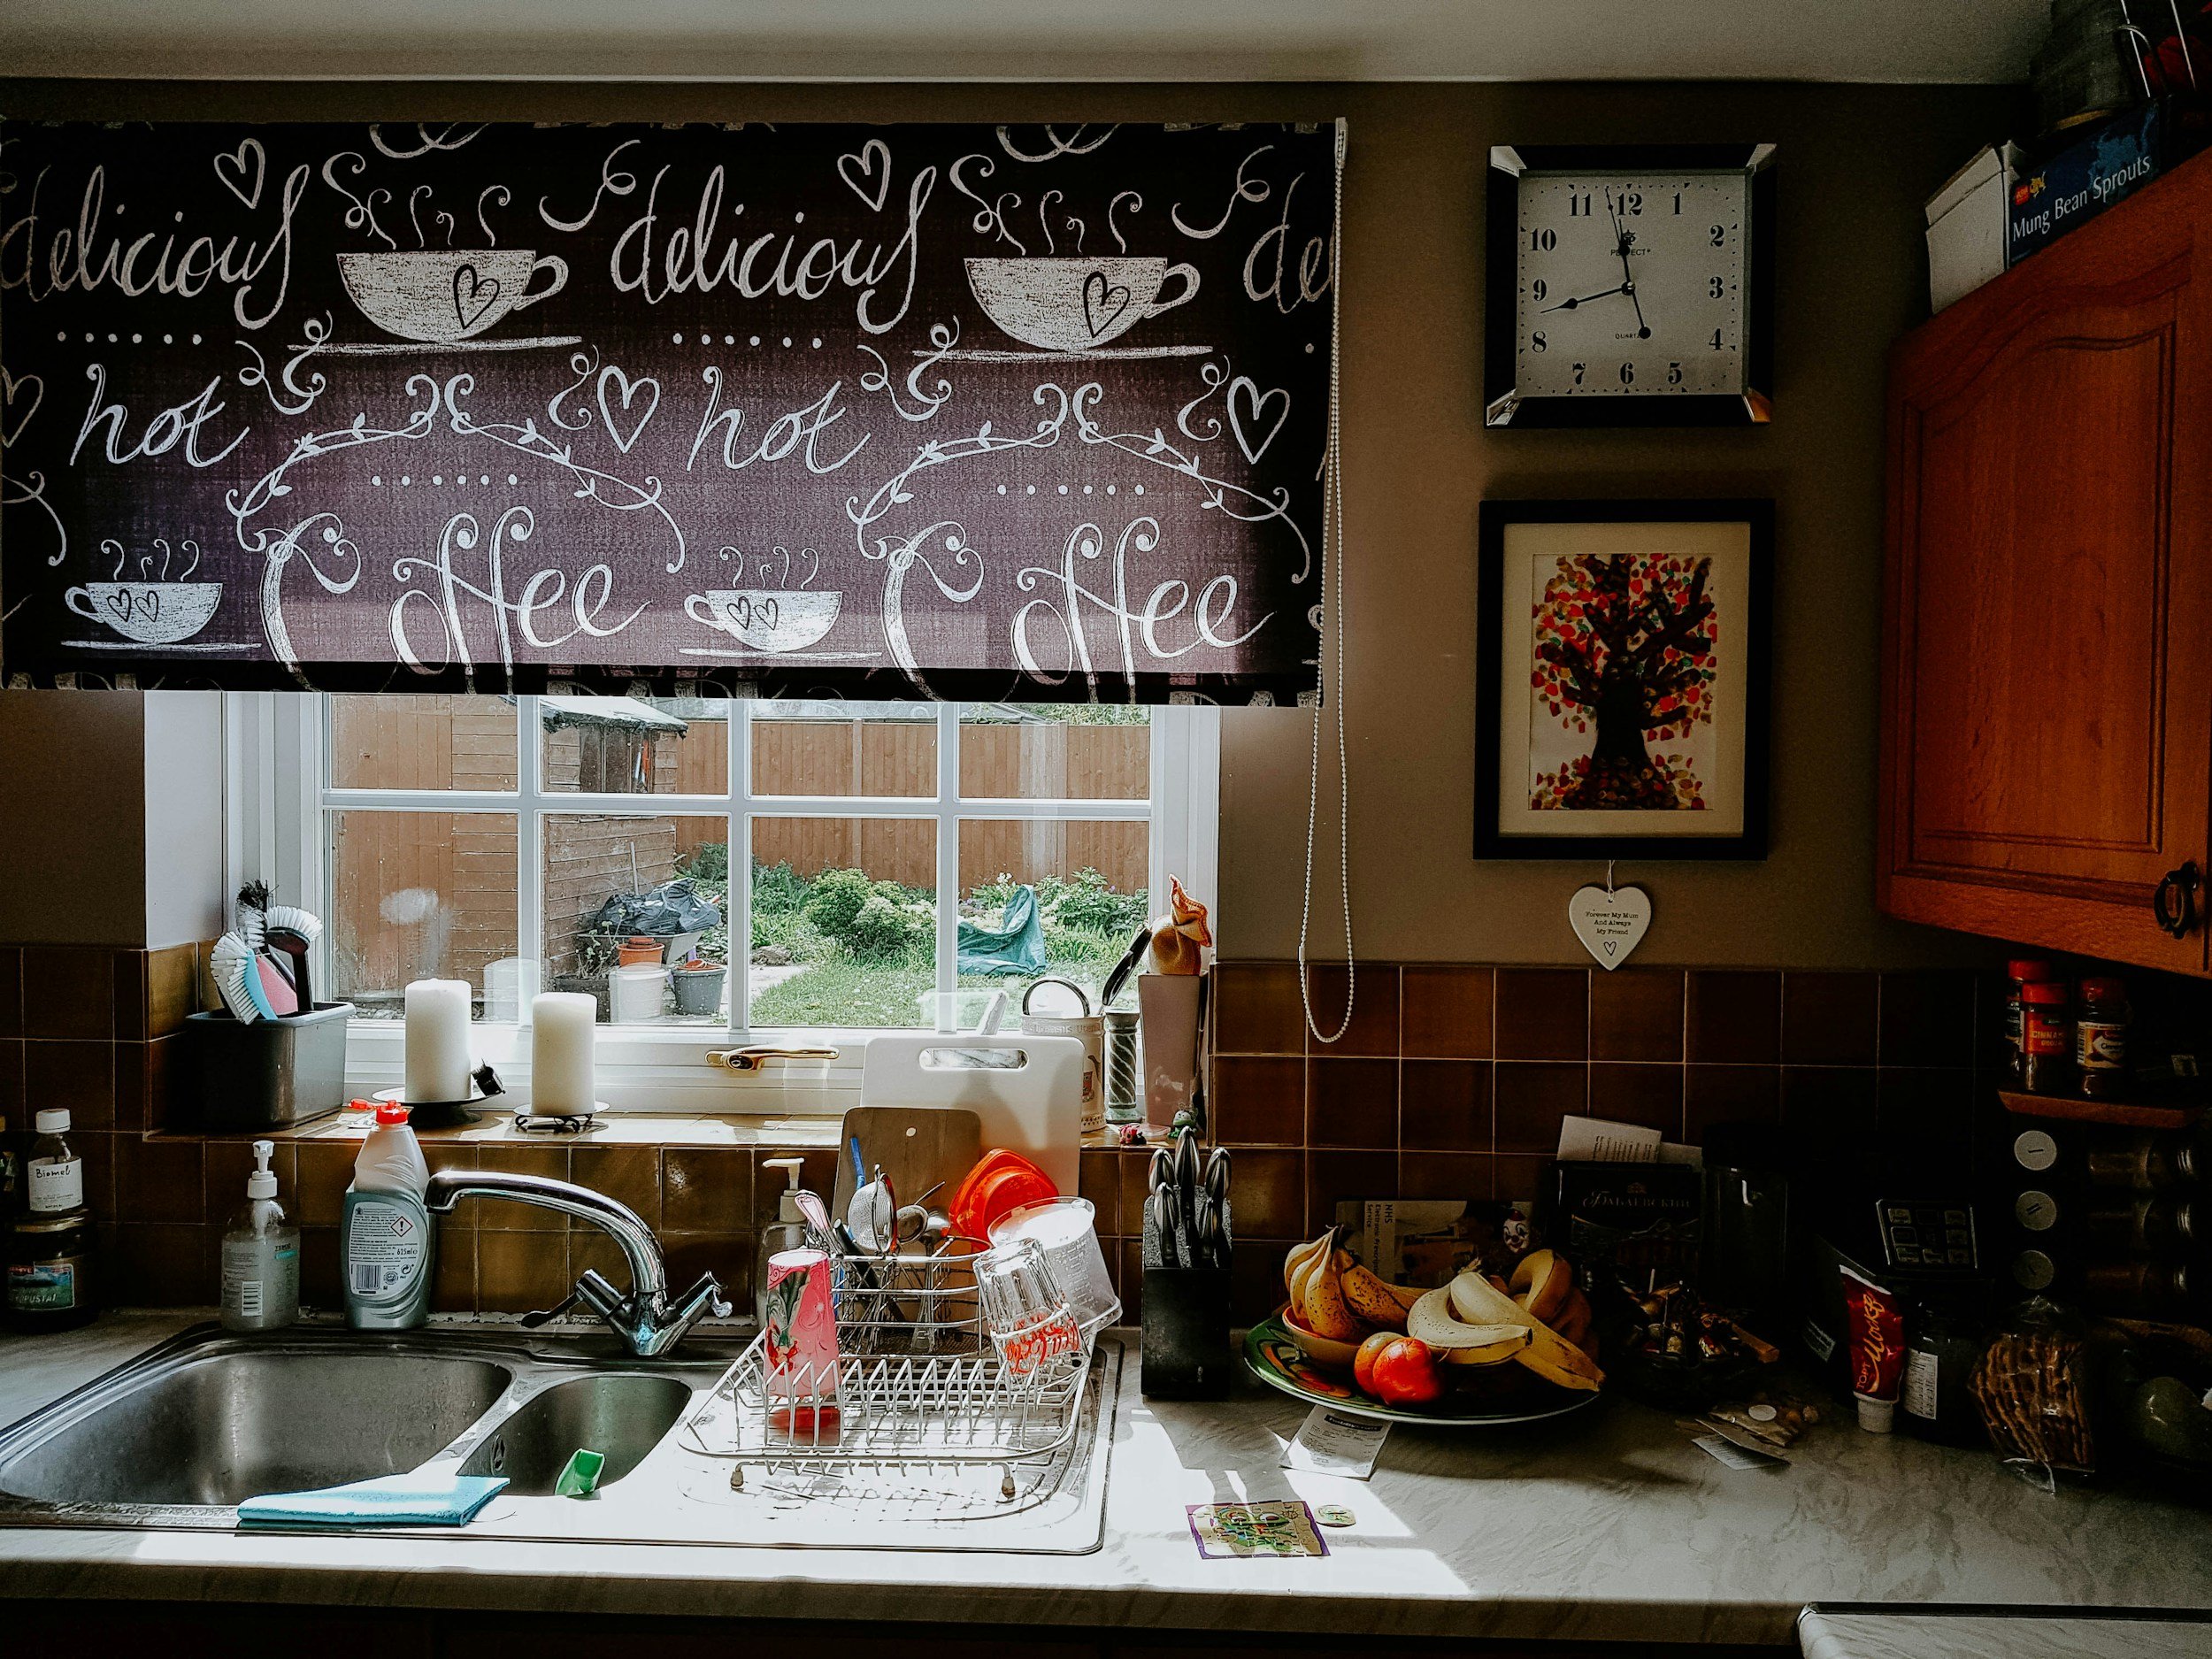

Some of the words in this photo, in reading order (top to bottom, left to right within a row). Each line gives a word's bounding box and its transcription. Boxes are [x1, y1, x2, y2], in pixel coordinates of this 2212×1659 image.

[1569, 193, 1592, 217] 11
[1616, 193, 1643, 216] 12
[1672, 192, 1682, 215] 1
[2013, 211, 2050, 243] Mung
[2055, 188, 2088, 221] Bean
[2093, 154, 2153, 204] Sprouts
[0, 165, 309, 330] delicious
[1530, 228, 1557, 251] 10
[1709, 225, 1724, 247] 2
[610, 164, 936, 335] delicious
[1533, 279, 1547, 301] 9
[1709, 276, 1724, 299] 3
[1532, 331, 1547, 353] 8
[1709, 328, 1724, 350] 4
[1572, 363, 1586, 385] 7
[1620, 363, 1634, 385] 6
[1668, 363, 1682, 384] 5
[69, 363, 250, 467] hot
[687, 365, 872, 474] hot
[258, 505, 652, 694] Coffee
[880, 515, 1279, 703] Coffee
[1384, 1203, 1394, 1224] NHS
